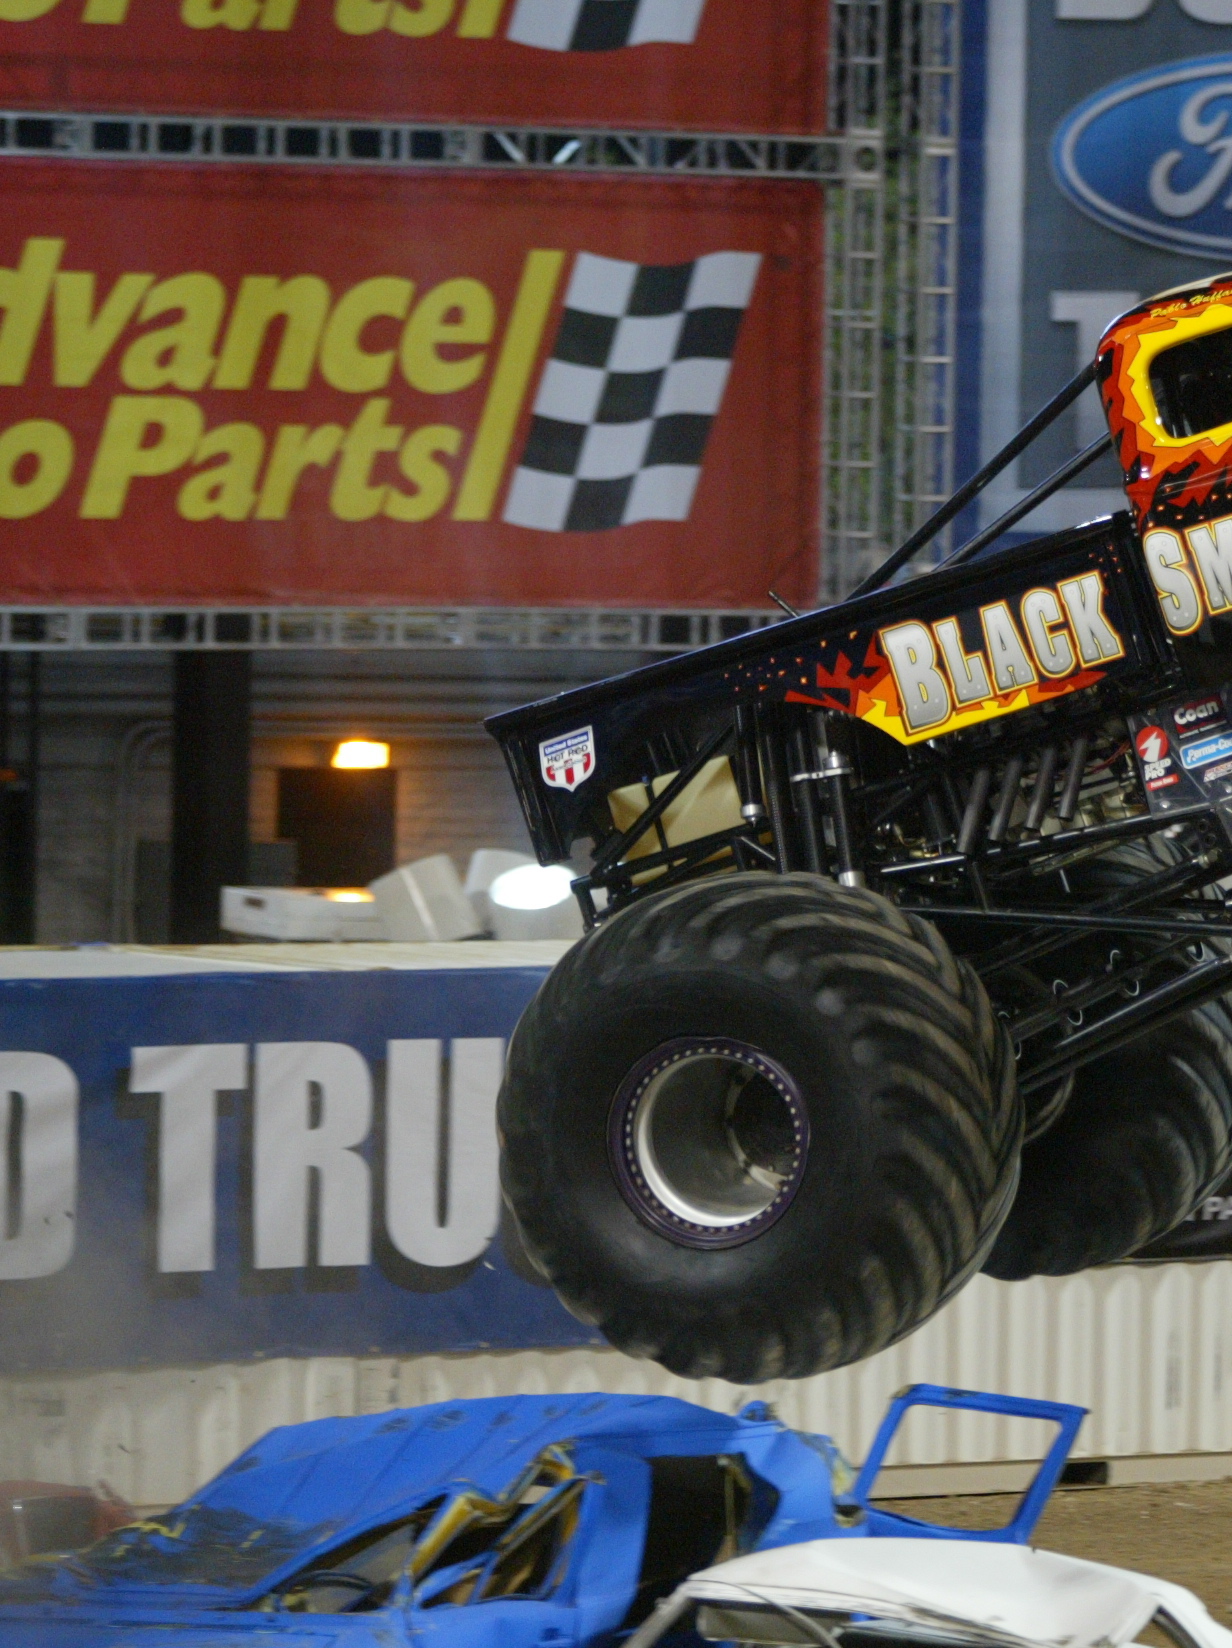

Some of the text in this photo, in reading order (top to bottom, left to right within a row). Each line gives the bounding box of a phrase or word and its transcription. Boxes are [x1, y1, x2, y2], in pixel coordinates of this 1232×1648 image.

[79, 395, 464, 522] Parts
[879, 570, 1124, 735] BLACK
[1174, 701, 1219, 725] Coan
[547, 744, 588, 764] HOT ROD
[1144, 757, 1172, 772] SPEED
[1145, 767, 1165, 781] PRO
